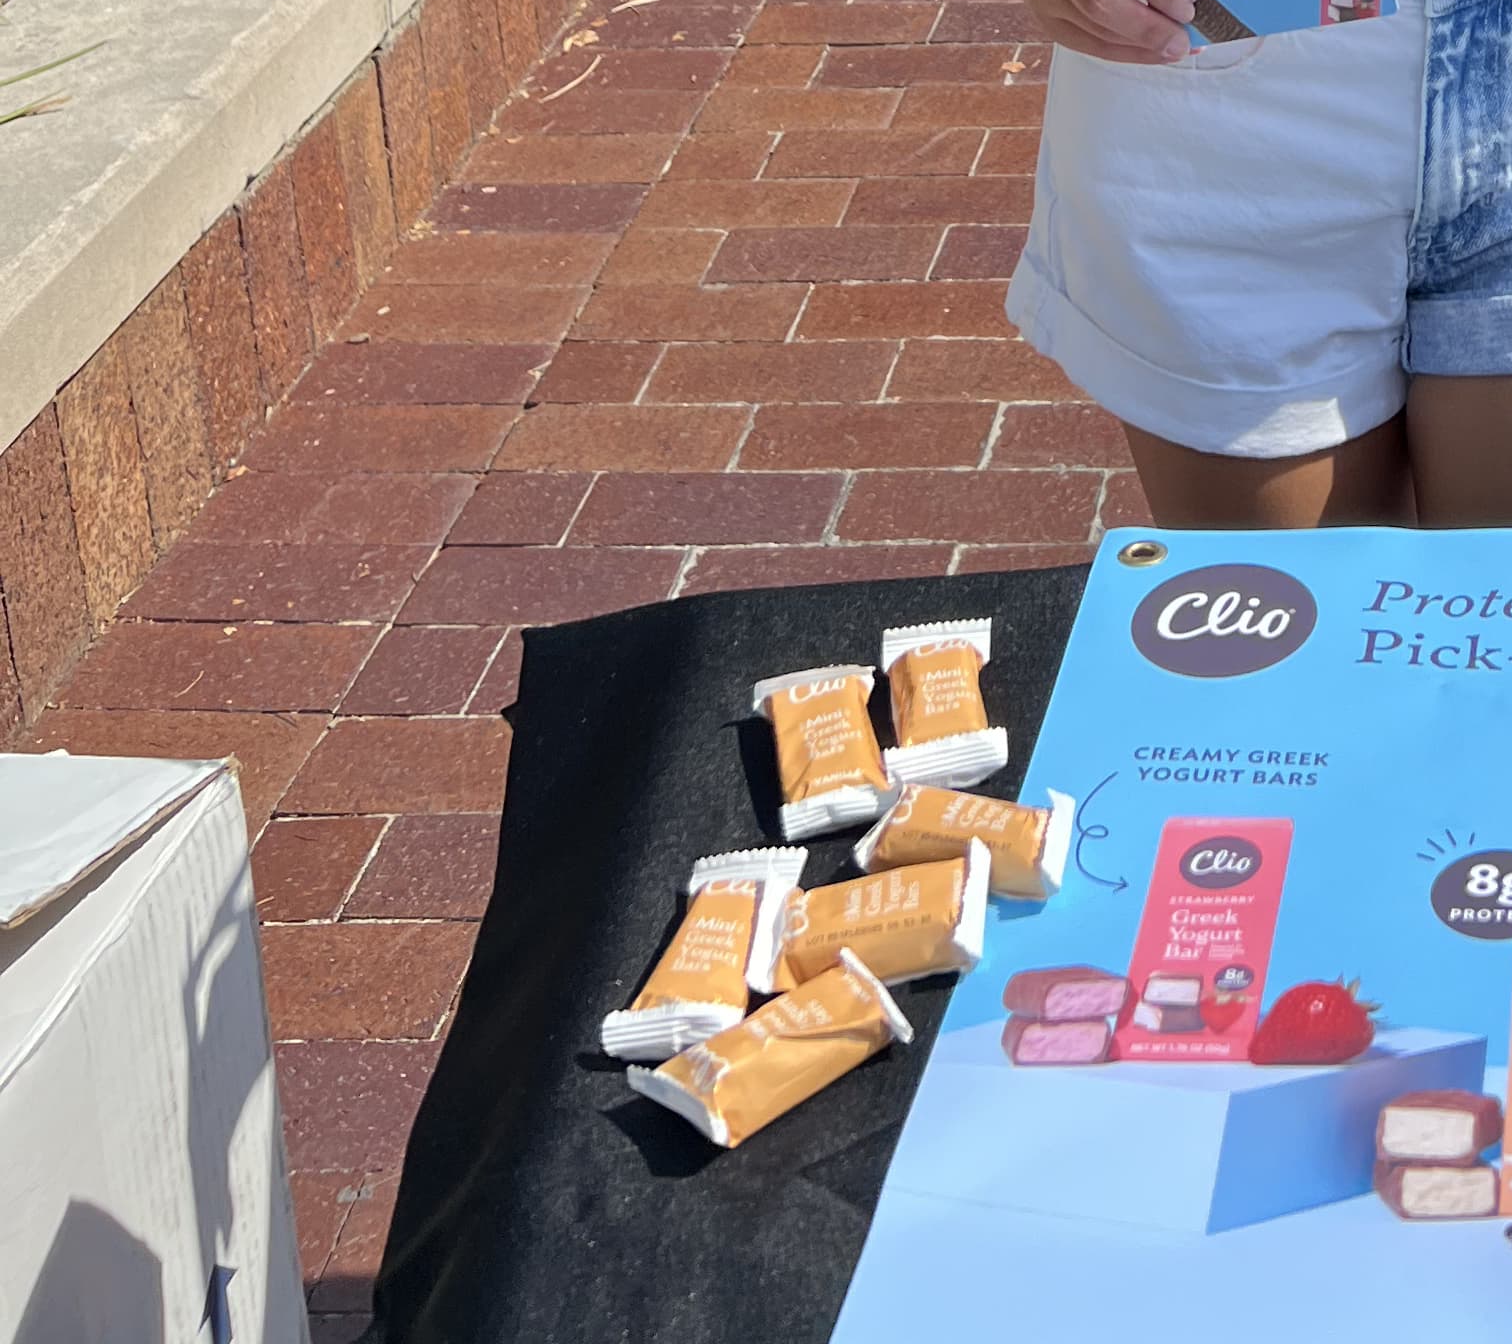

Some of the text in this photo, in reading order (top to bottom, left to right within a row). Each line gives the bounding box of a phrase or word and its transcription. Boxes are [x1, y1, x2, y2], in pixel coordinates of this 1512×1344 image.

[1156, 591, 1292, 640] Clio
[1133, 745, 1330, 767] CREAMY GREEK
[1137, 766, 1318, 787] YOGURT BARS
[1189, 848, 1252, 876] Clio
[1169, 895, 1255, 906] STRAWBERRY
[1171, 909, 1238, 926] Greek
[1168, 925, 1243, 946] Yogurt
[1163, 943, 1203, 961] Bar
